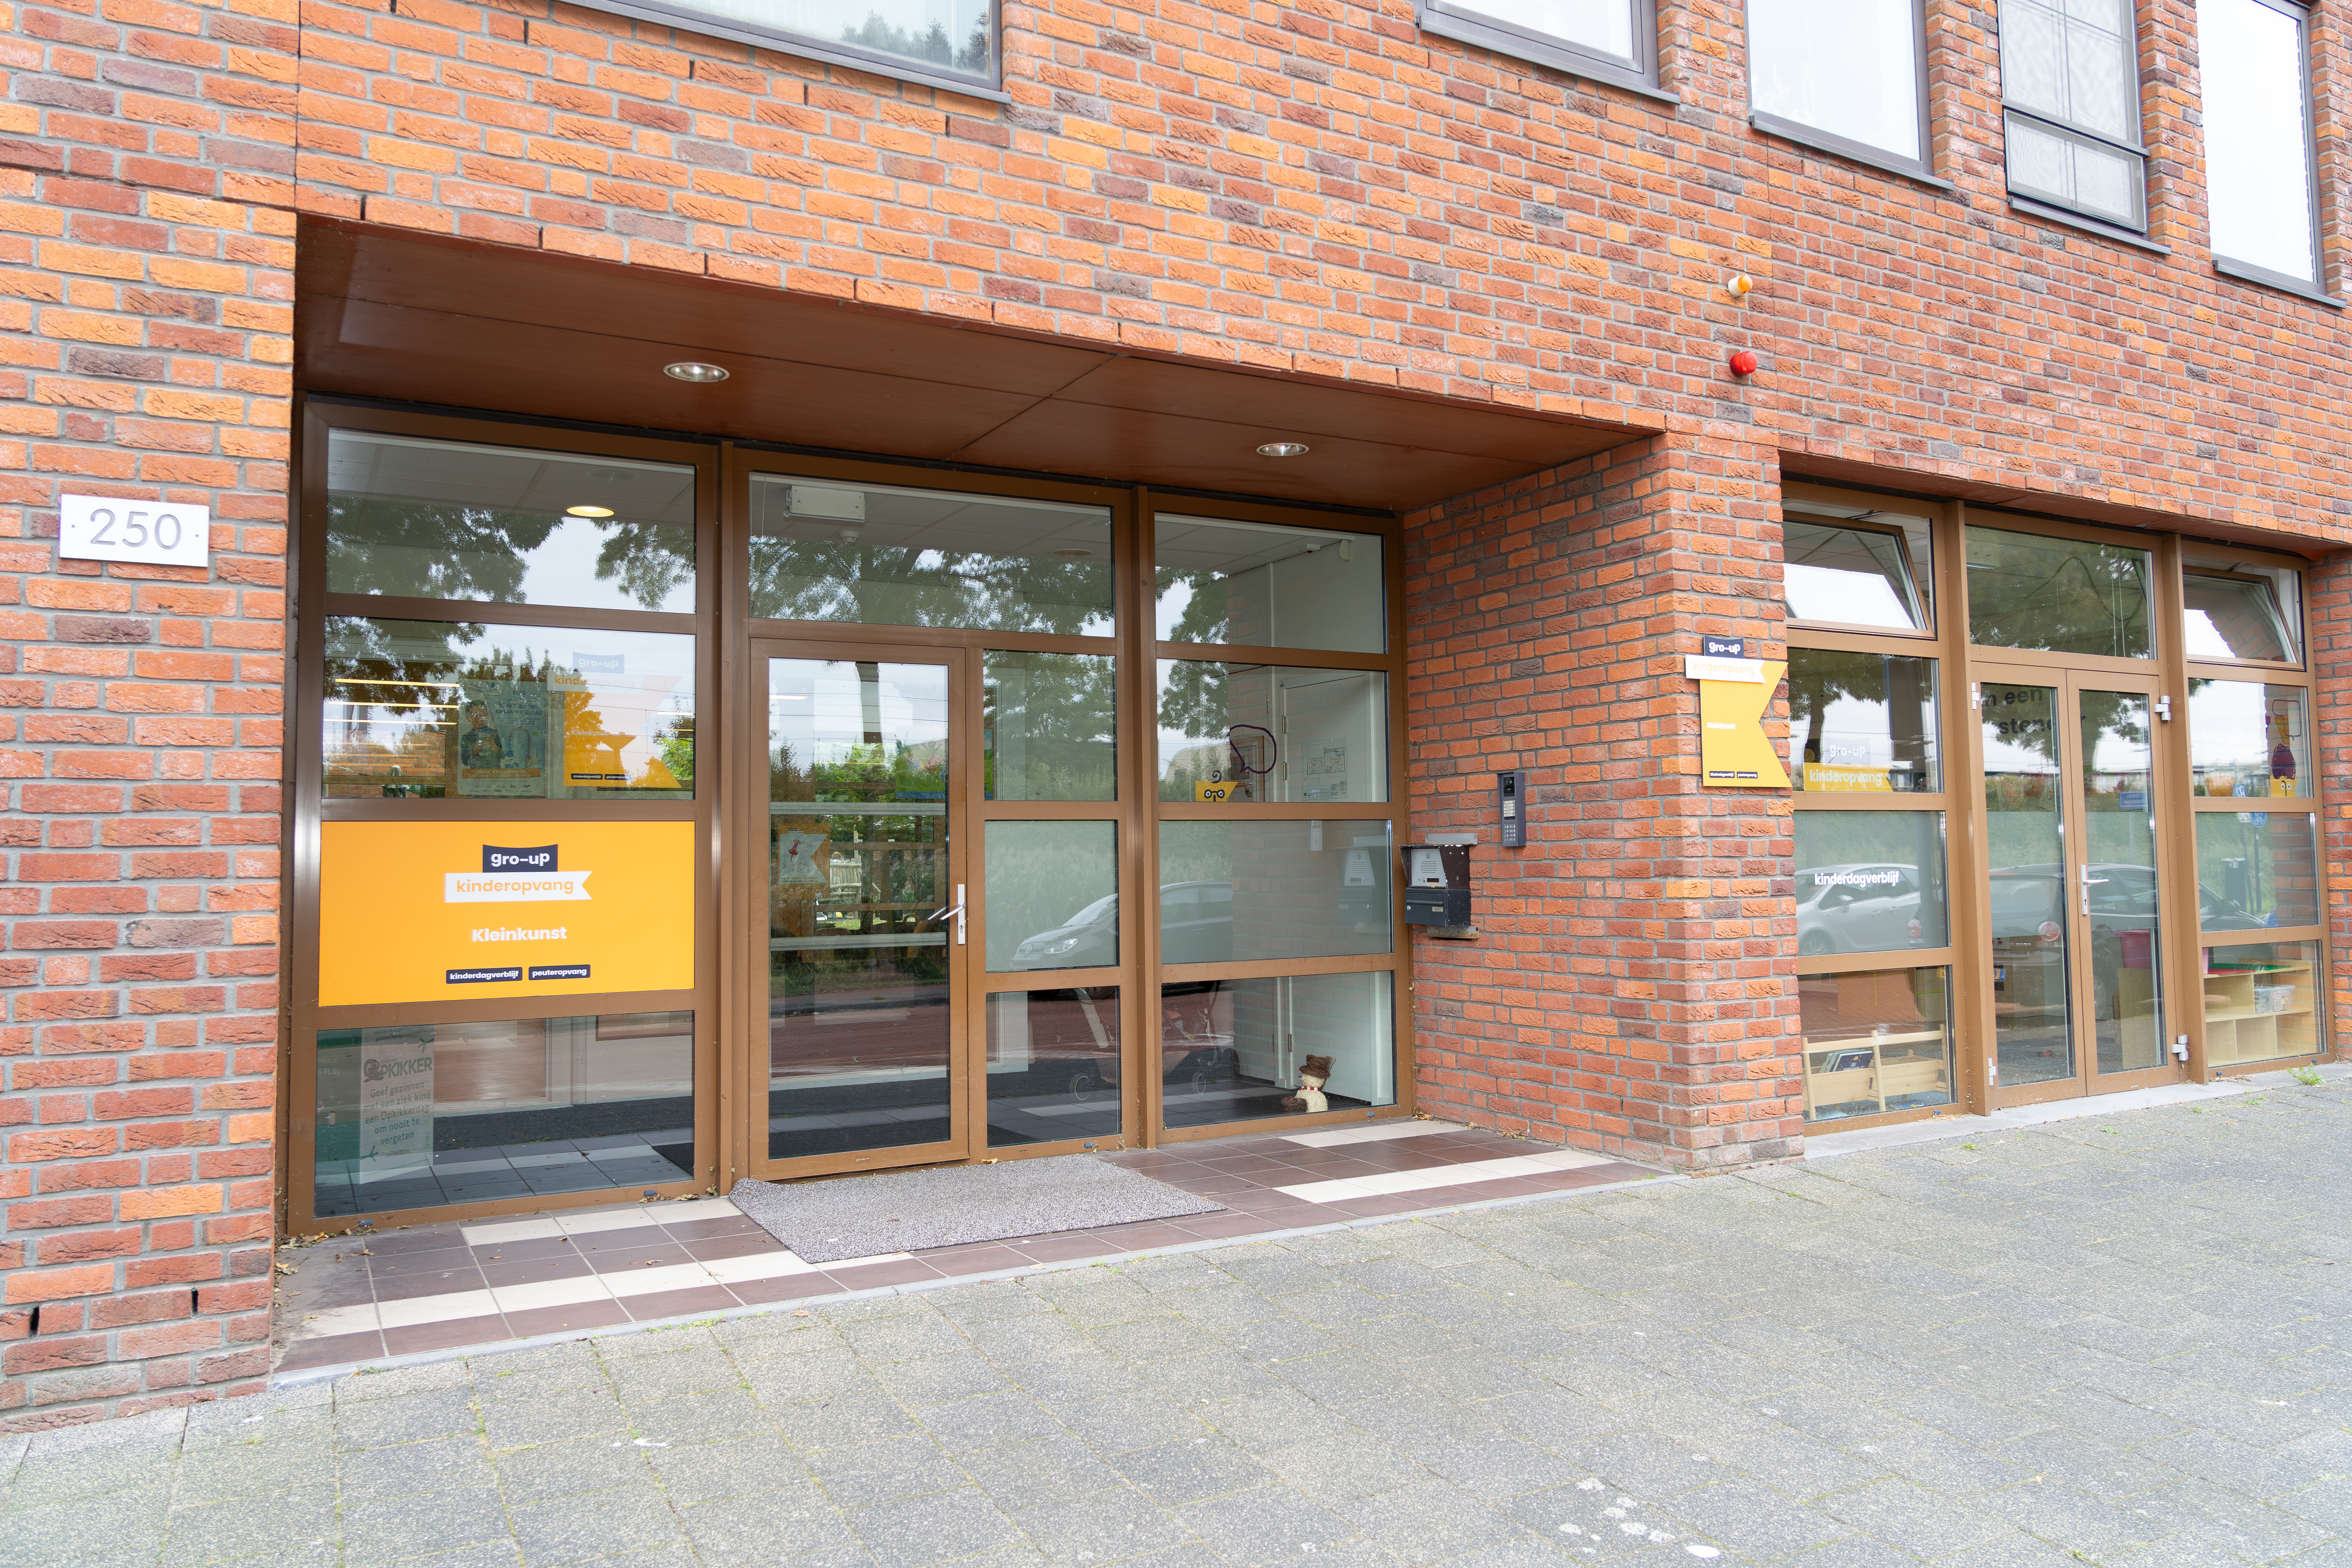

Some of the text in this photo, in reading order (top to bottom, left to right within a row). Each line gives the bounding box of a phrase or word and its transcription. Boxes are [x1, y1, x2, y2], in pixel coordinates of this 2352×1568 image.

[91, 509, 181, 550] 250
[1709, 642, 1740, 655] gro-up
[579, 658, 619, 669] gro-up
[1694, 661, 1755, 677] kinderopvang
[555, 675, 636, 690] kinderopvang
[2004, 688, 2043, 705] een
[1829, 745, 1866, 759] gro-up
[1809, 769, 1882, 787] kinderopvang
[491, 853, 550, 867] gro-up
[457, 879, 573, 895] kinderopvang
[1815, 871, 1899, 888] kinderdagverblijf
[472, 927, 567, 942] Kleinkunst
[450, 969, 587, 980] kinderdagverblijf peuteropvang
[370, 1082, 424, 1098] Geef gezinnen
[364, 1102, 379, 1112] met
[397, 1094, 412, 1105] ziek
[415, 1090, 431, 1101] kind
[365, 1104, 430, 1124] een Opkikkerdag
[375, 1126, 387, 1134] om
[389, 1120, 409, 1131] nooit
[381, 1132, 414, 1145] vergeten
